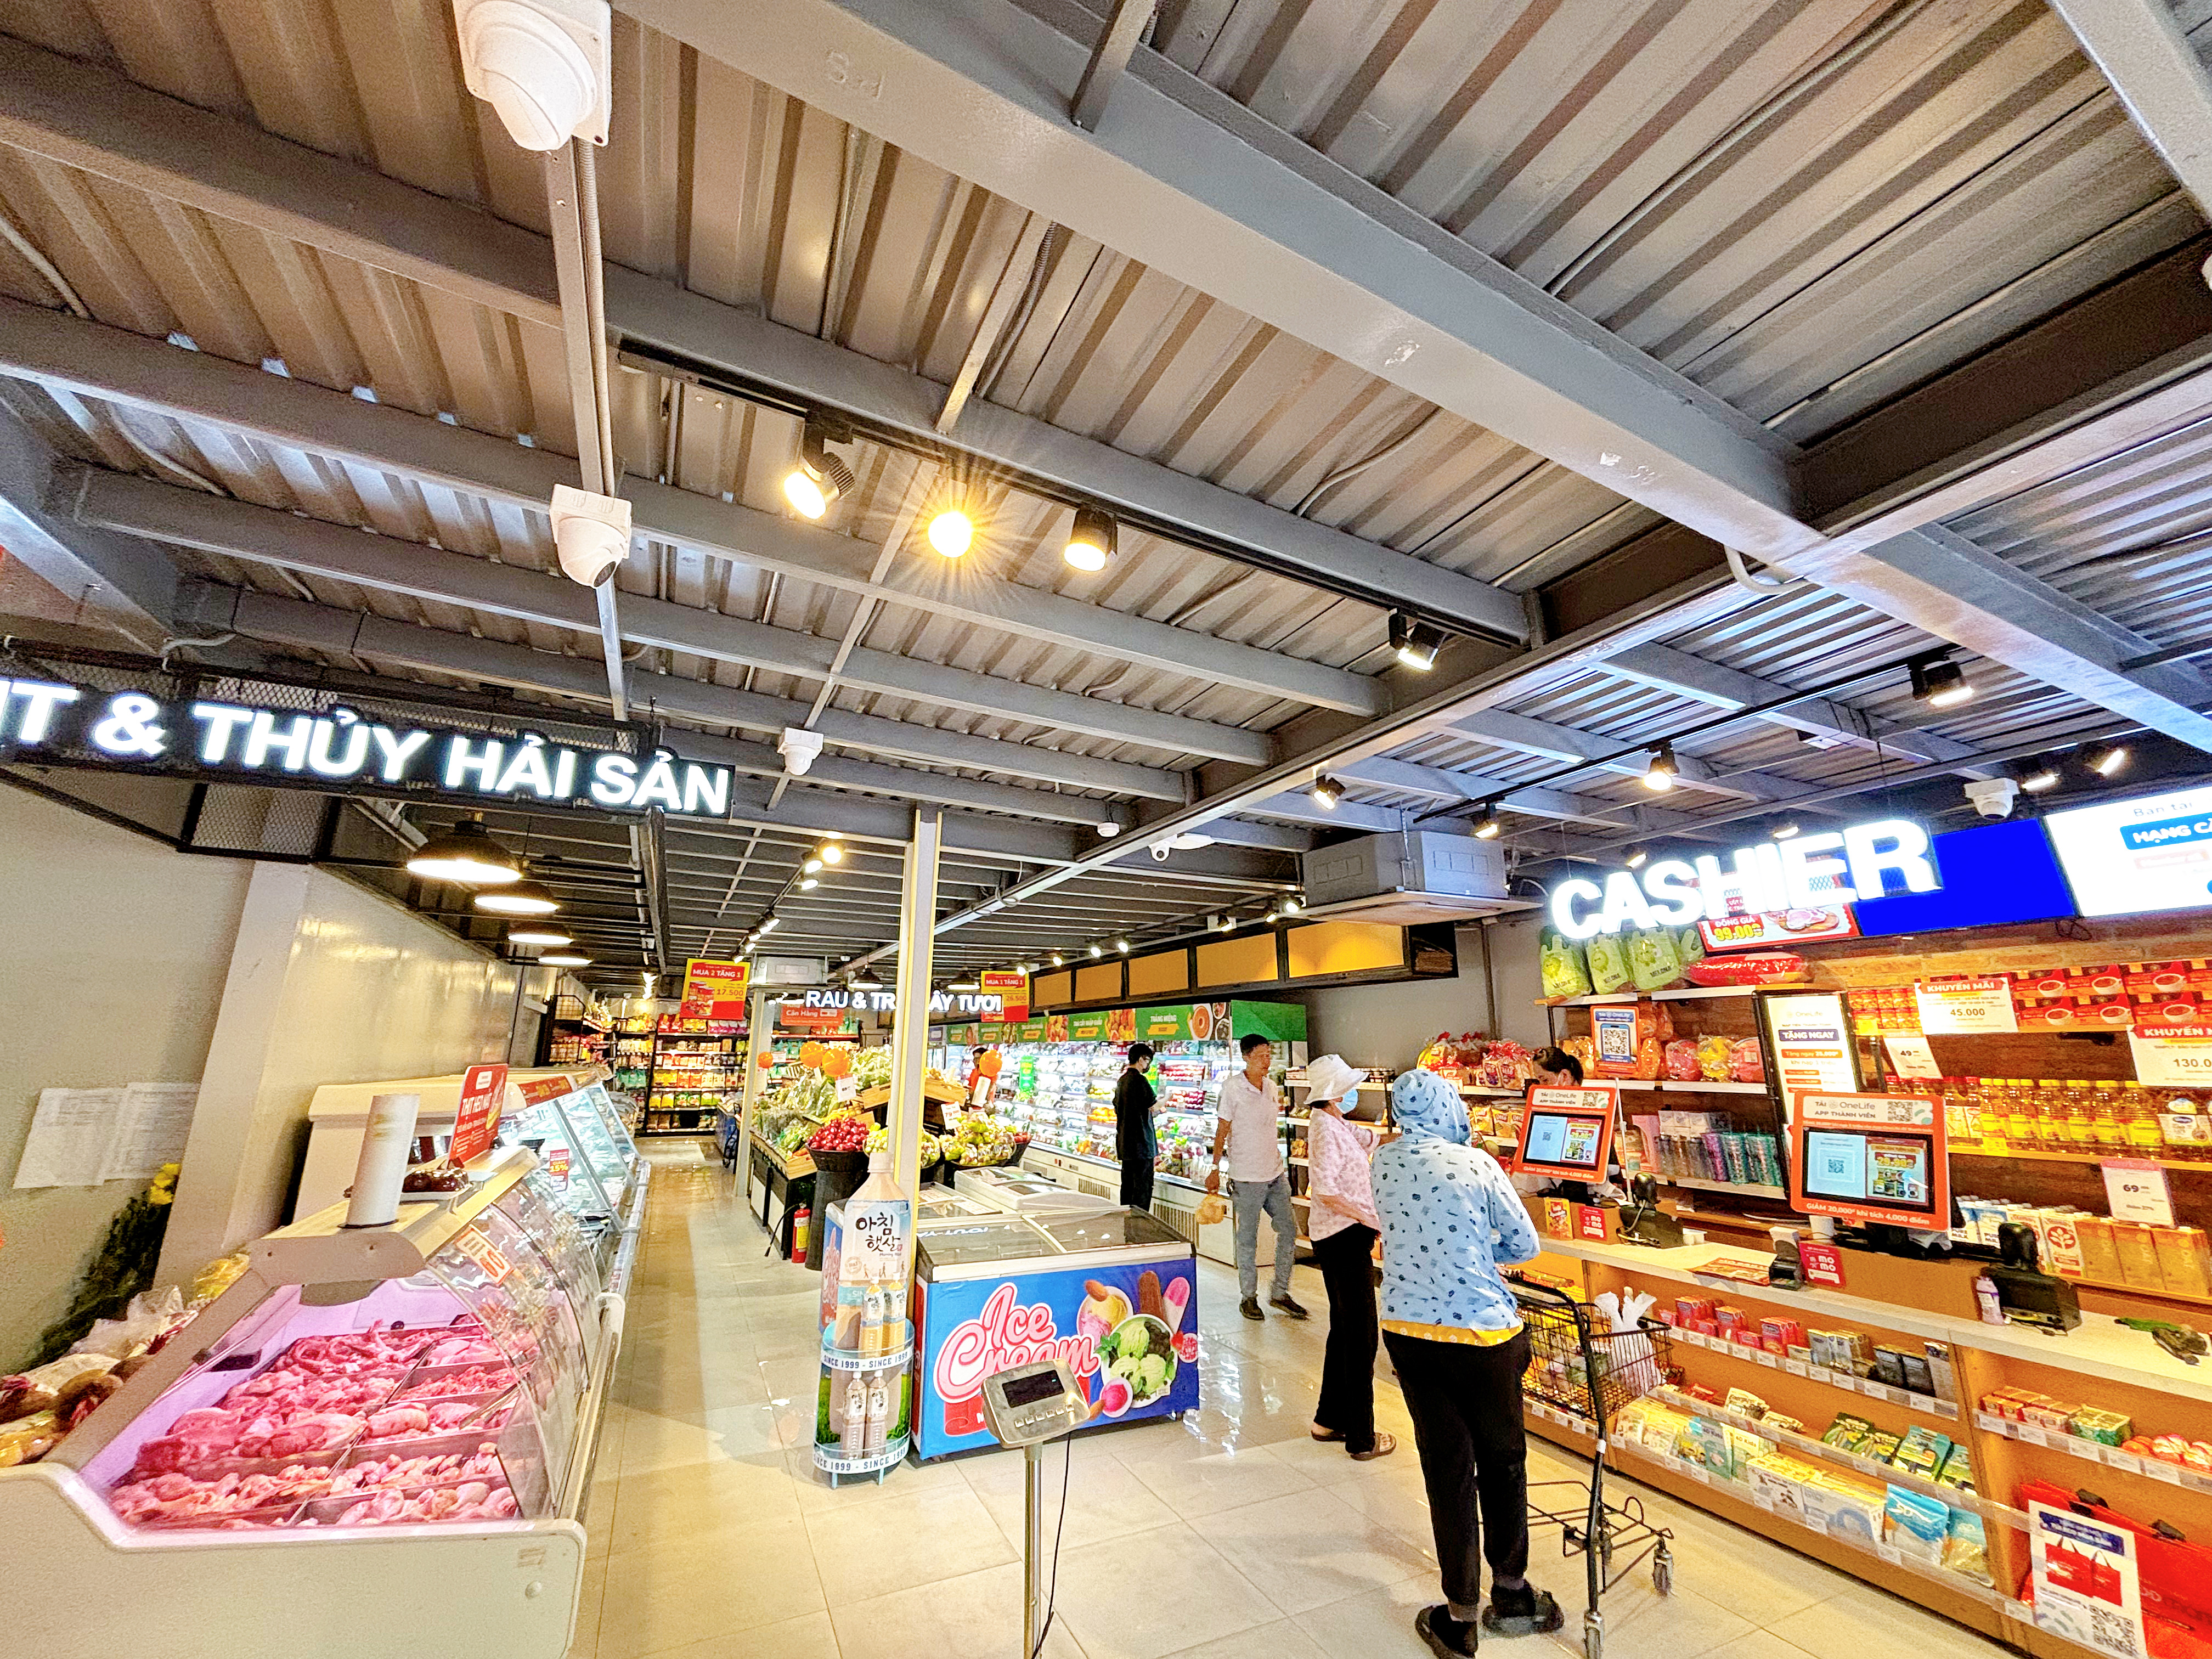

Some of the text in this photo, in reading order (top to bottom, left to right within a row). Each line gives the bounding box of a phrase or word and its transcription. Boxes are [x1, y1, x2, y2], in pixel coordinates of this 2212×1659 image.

[93, 693, 166, 758] &
[192, 702, 431, 783] THỦY
[442, 733, 574, 799] HẢI
[591, 748, 731, 815] SẢN
[2133, 825, 2192, 843] HẠNG
[1551, 819, 1943, 939] CASHIER
[716, 969, 736, 978] TẶNG
[1927, 980, 1995, 992] KHUYẾN MÃI
[806, 990, 849, 1008] RAU
[852, 991, 867, 1009] &
[871, 992, 896, 1010] TR
[929, 990, 955, 1011] ÂY
[1782, 1030, 1808, 1040] TẶNG
[2144, 1025, 2204, 1036] KHUYẾN
[550, 1164, 568, 1172] 15%
[2123, 1184, 2139, 1192] 69
[1806, 1203, 1826, 1211] GIẢM
[1885, 1214, 1908, 1222] 4,000
[856, 1212, 893, 1235] 아침
[865, 1235, 901, 1252] 햇살
[982, 1284, 1054, 1350] Ice
[824, 1355, 838, 1367] SINCE
[842, 1361, 859, 1369] 1999
[869, 1358, 891, 1368] SINCE
[895, 1351, 908, 1363] 1999
[936, 1322, 1099, 1400] Cream
[831, 1462, 851, 1471] 1999
[864, 1457, 889, 1469] SINCE
